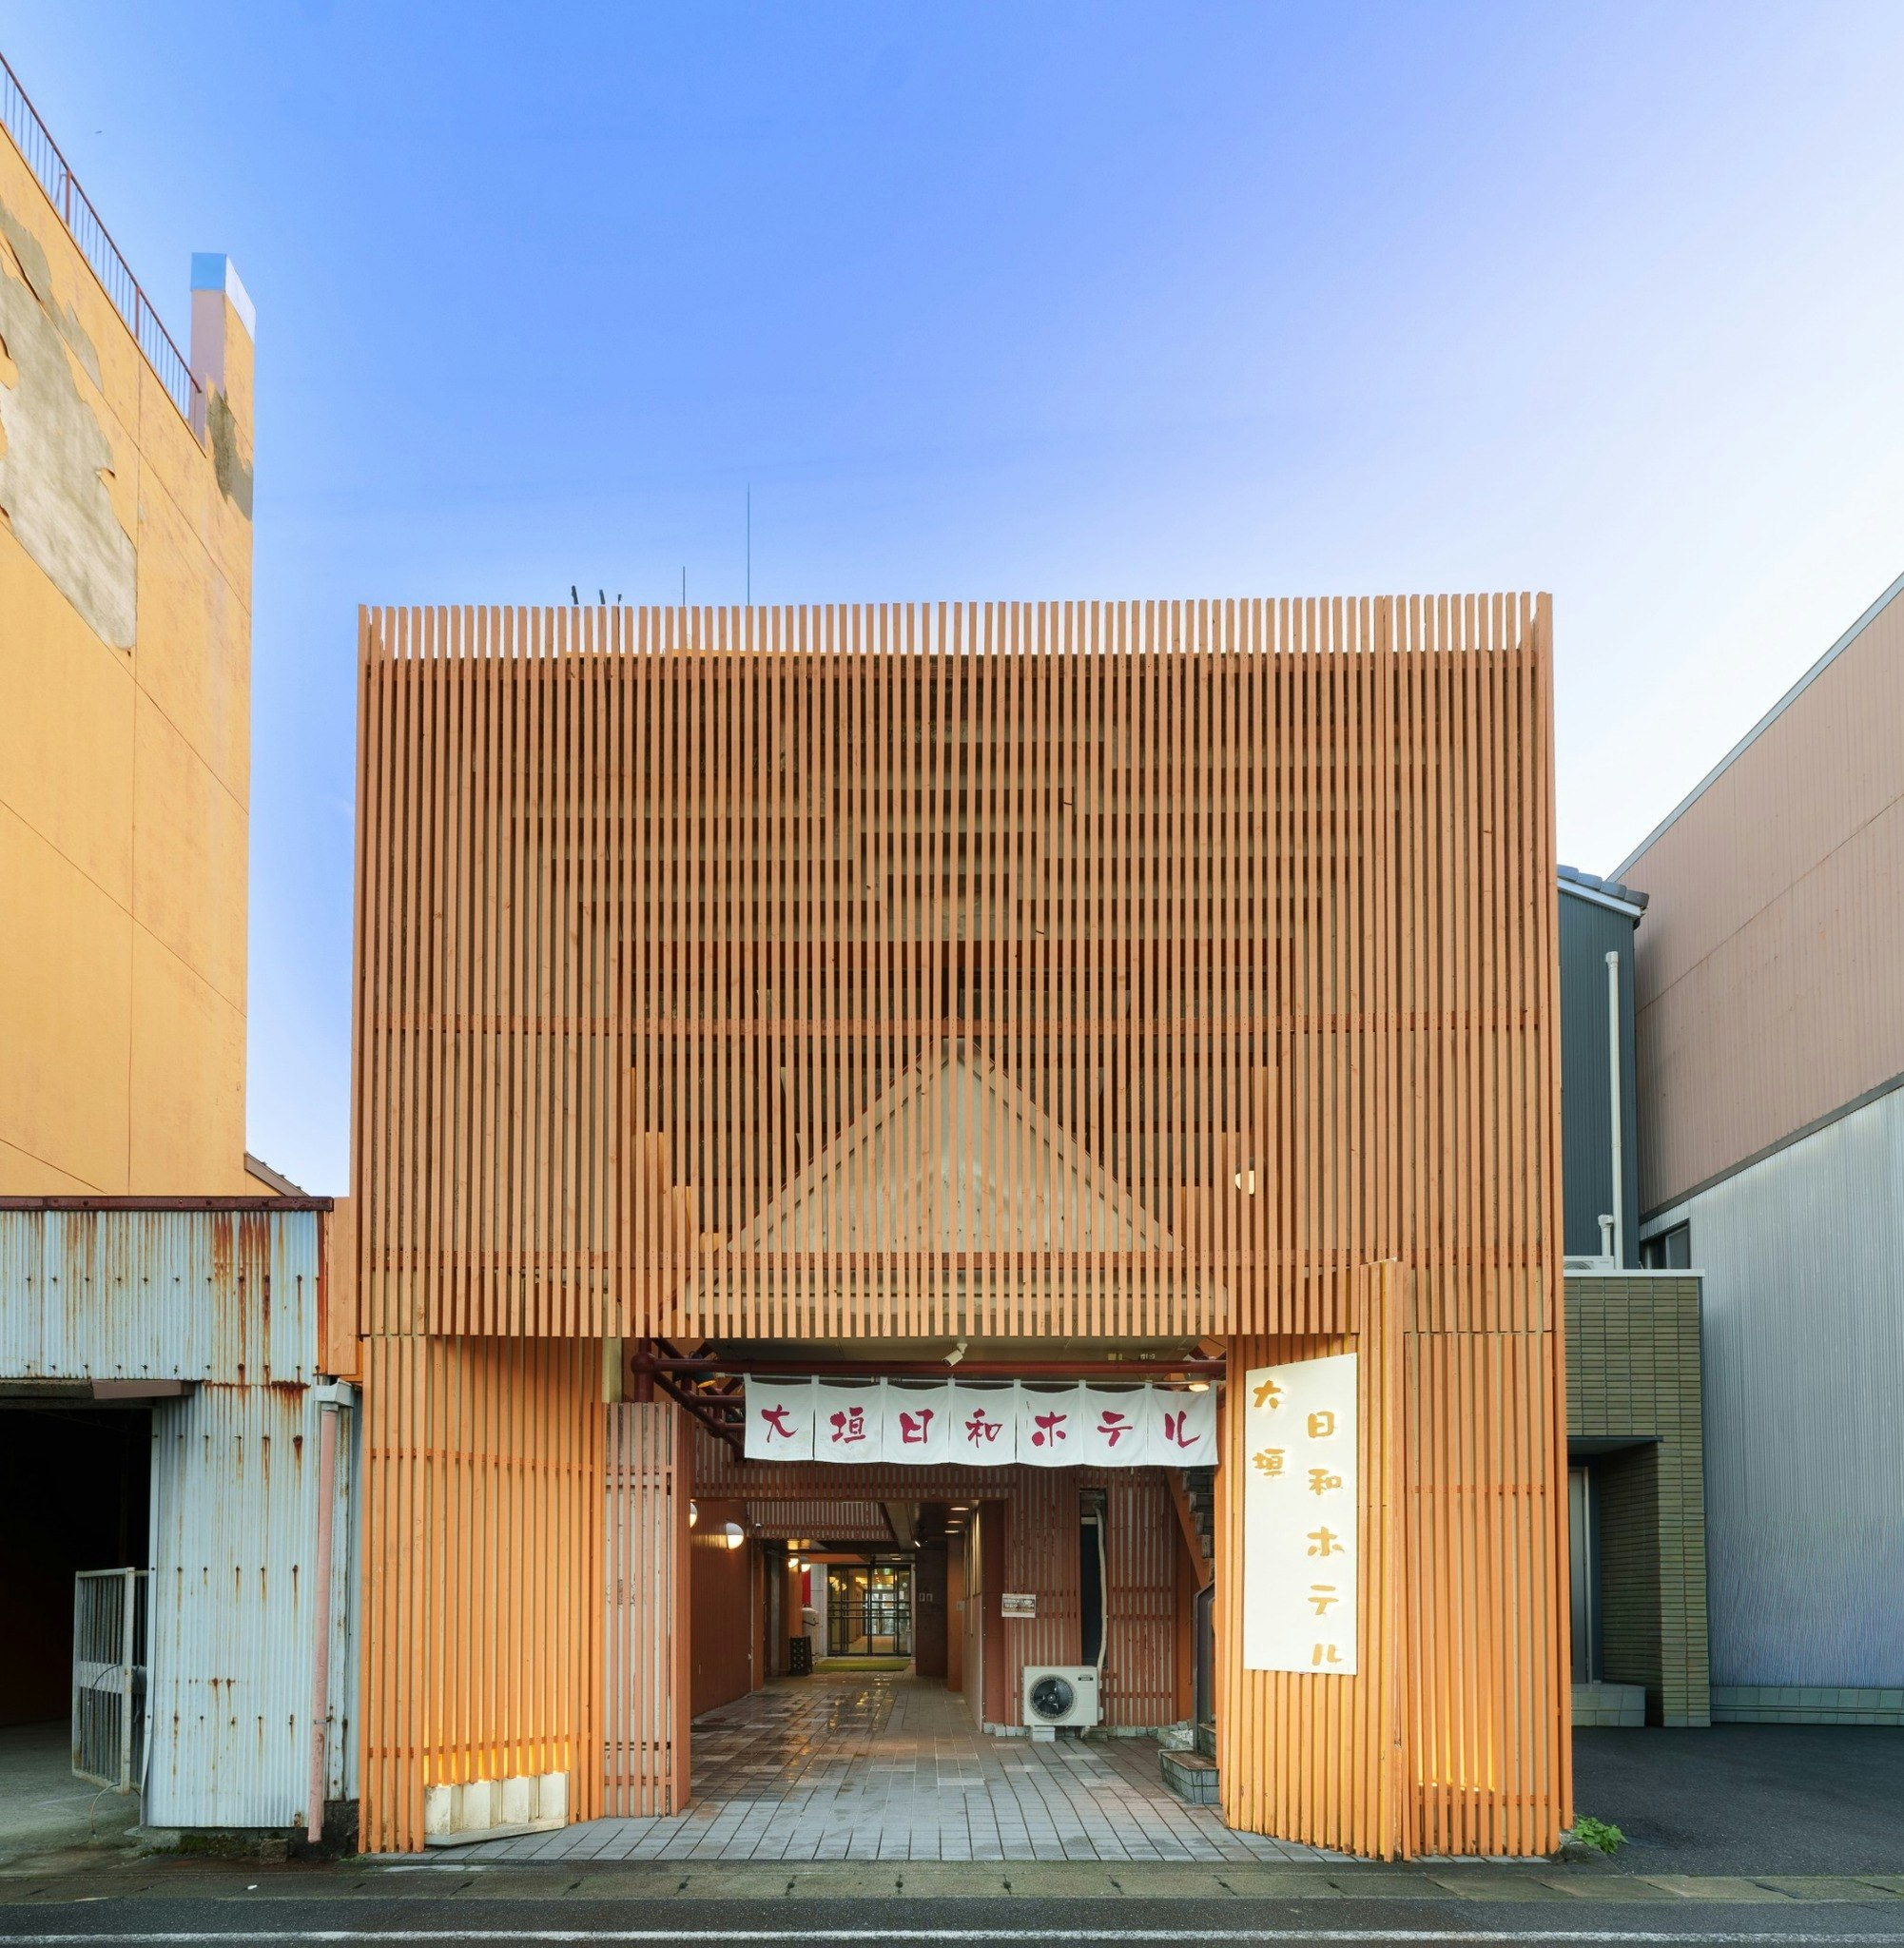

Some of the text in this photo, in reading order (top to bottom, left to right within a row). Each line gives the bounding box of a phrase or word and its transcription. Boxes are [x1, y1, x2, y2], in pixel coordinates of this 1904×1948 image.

[761, 1403, 1201, 1449] 大垣日和ホテル
[1252, 1376, 1284, 1478] 大垣
[1306, 1411, 1343, 1666] 日和ホテル
